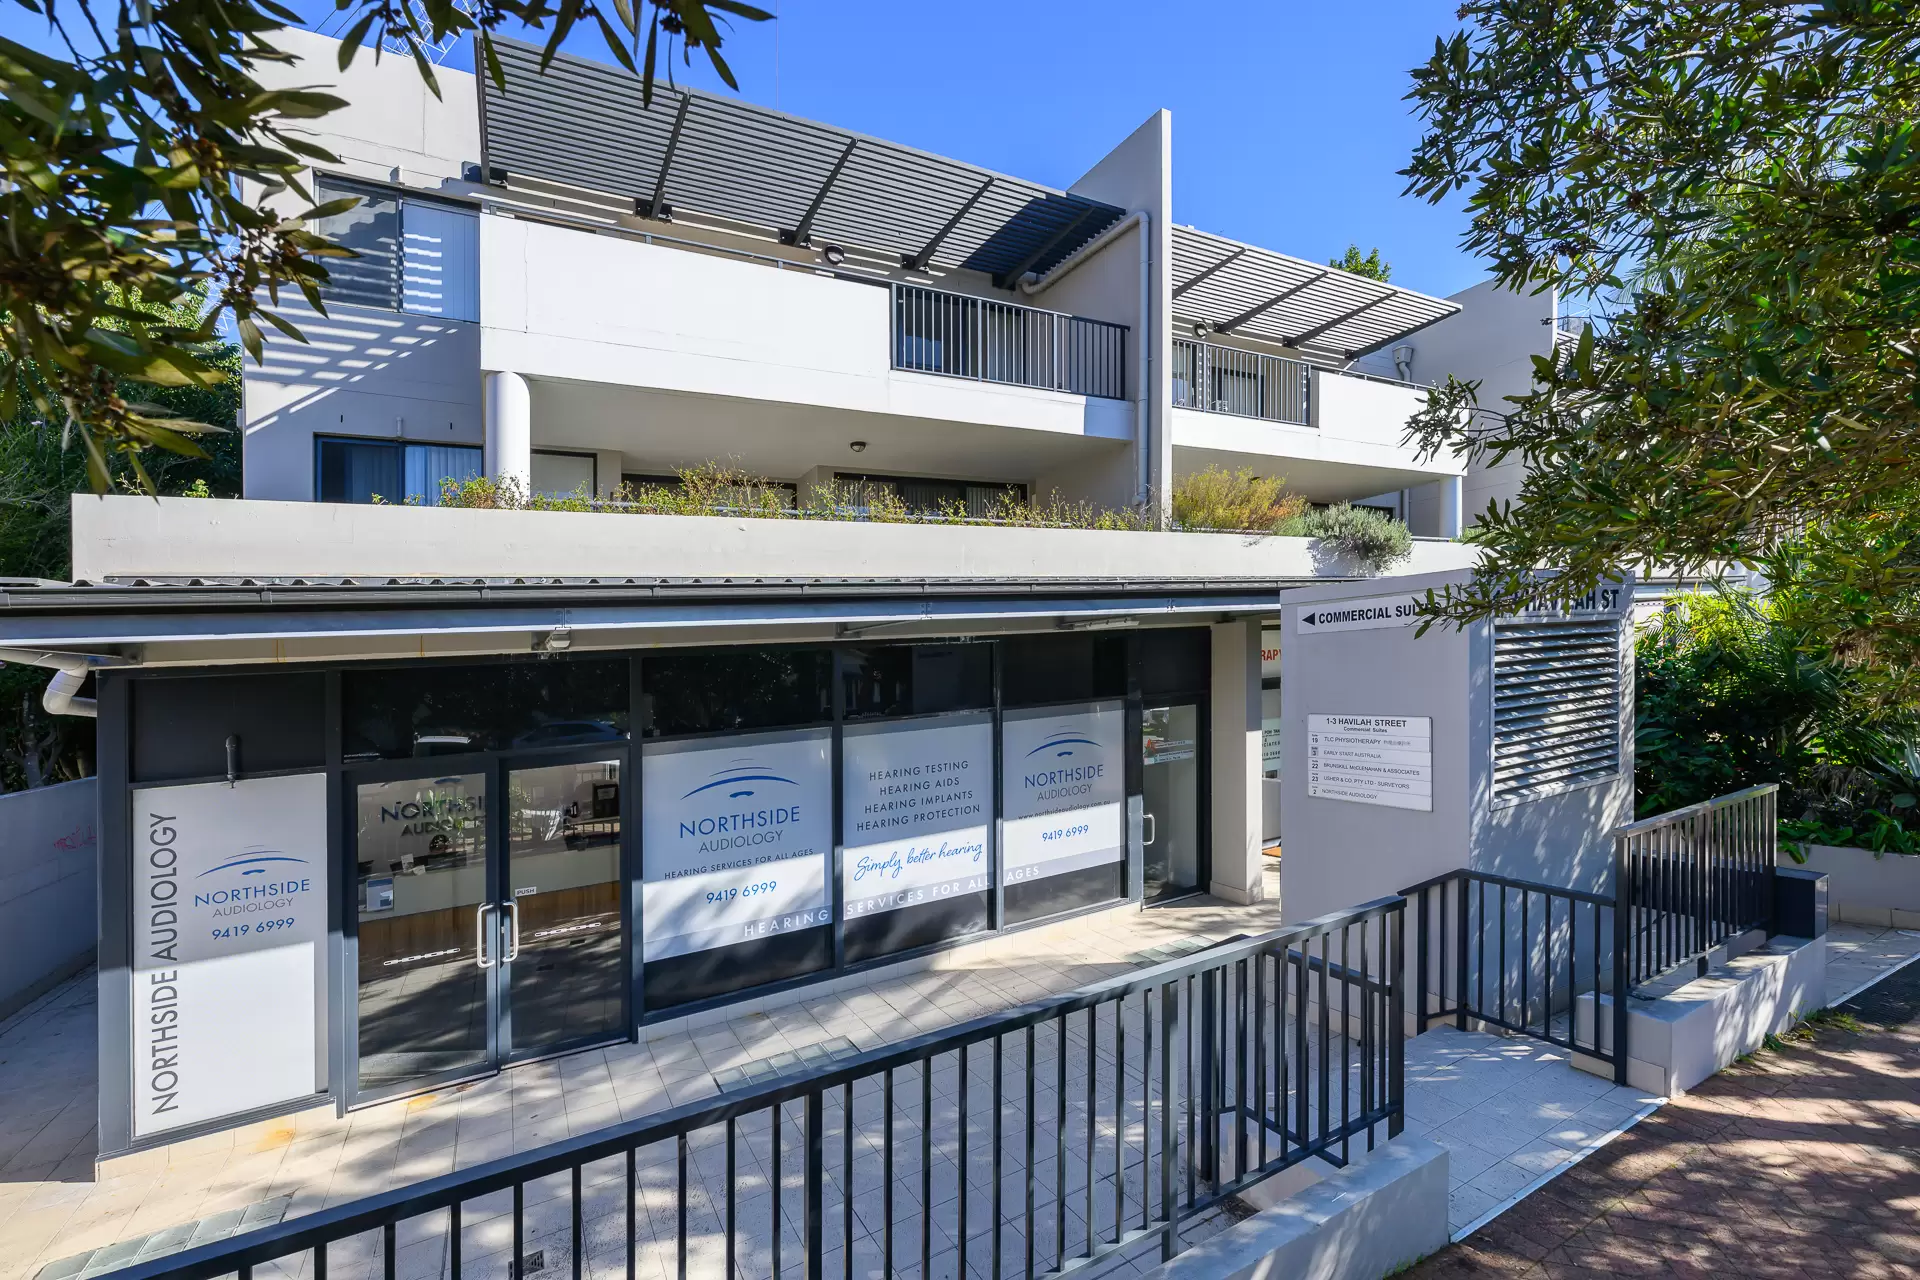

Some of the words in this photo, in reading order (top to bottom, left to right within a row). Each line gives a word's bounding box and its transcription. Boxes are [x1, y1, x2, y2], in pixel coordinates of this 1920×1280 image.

[1601, 588, 1620, 610] ST
[1318, 607, 1392, 624] COMMERCIAL
[1326, 717, 1337, 725] 1-3
[1338, 717, 1372, 726] HAVILAH
[1374, 719, 1407, 728] STREET
[1335, 736, 1381, 745] PHYSIOTHERAPY
[869, 766, 921, 781] HEARING
[925, 760, 969, 774] TESTING
[1024, 764, 1104, 789] NORTHSIDE
[1387, 768, 1420, 776] ASSOCIATES
[879, 780, 931, 796] HEARING
[934, 777, 960, 788] AIDS
[1036, 783, 1093, 802] AUDIOLOGY
[1321, 788, 1348, 796] NORTHSIDE
[1348, 791, 1378, 799] AUDIOLOGY
[1377, 781, 1410, 789] SURVEYORS
[864, 798, 917, 814] HEARING
[921, 790, 973, 806] IMPLANTS
[1018, 800, 1111, 820] www.northsideaudiology.com.au
[679, 805, 800, 839] NORTHSIDE
[856, 815, 909, 832] HEARING
[913, 804, 980, 823] PROTECTION
[698, 830, 784, 854] AUDIOLOGY
[1042, 829, 1063, 842] 9419
[1065, 824, 1089, 837] 6999
[664, 866, 707, 880] HEARING
[710, 858, 752, 872] SERVICES
[755, 855, 772, 865] FOR
[774, 852, 789, 861] ALL
[791, 848, 814, 859] AGES
[853, 851, 903, 882] Simply
[906, 848, 937, 865] better
[938, 842, 983, 862] hearing
[149, 812, 178, 962] AUDIOLOGY
[194, 878, 310, 907] NORTHSIDE
[516, 887, 536, 896] PUSH
[706, 888, 738, 904] 9419
[742, 881, 777, 897] 6999
[212, 897, 294, 918] AUDIOLOGY
[744, 909, 829, 937] HEARING
[846, 889, 924, 916] SERVICES
[932, 882, 960, 897] FOR
[968, 875, 990, 889] ALL
[1006, 865, 1040, 882] AGES
[211, 924, 250, 940] 9419
[255, 917, 295, 933] 6999
[150, 969, 179, 1115] NORTHSIDE
